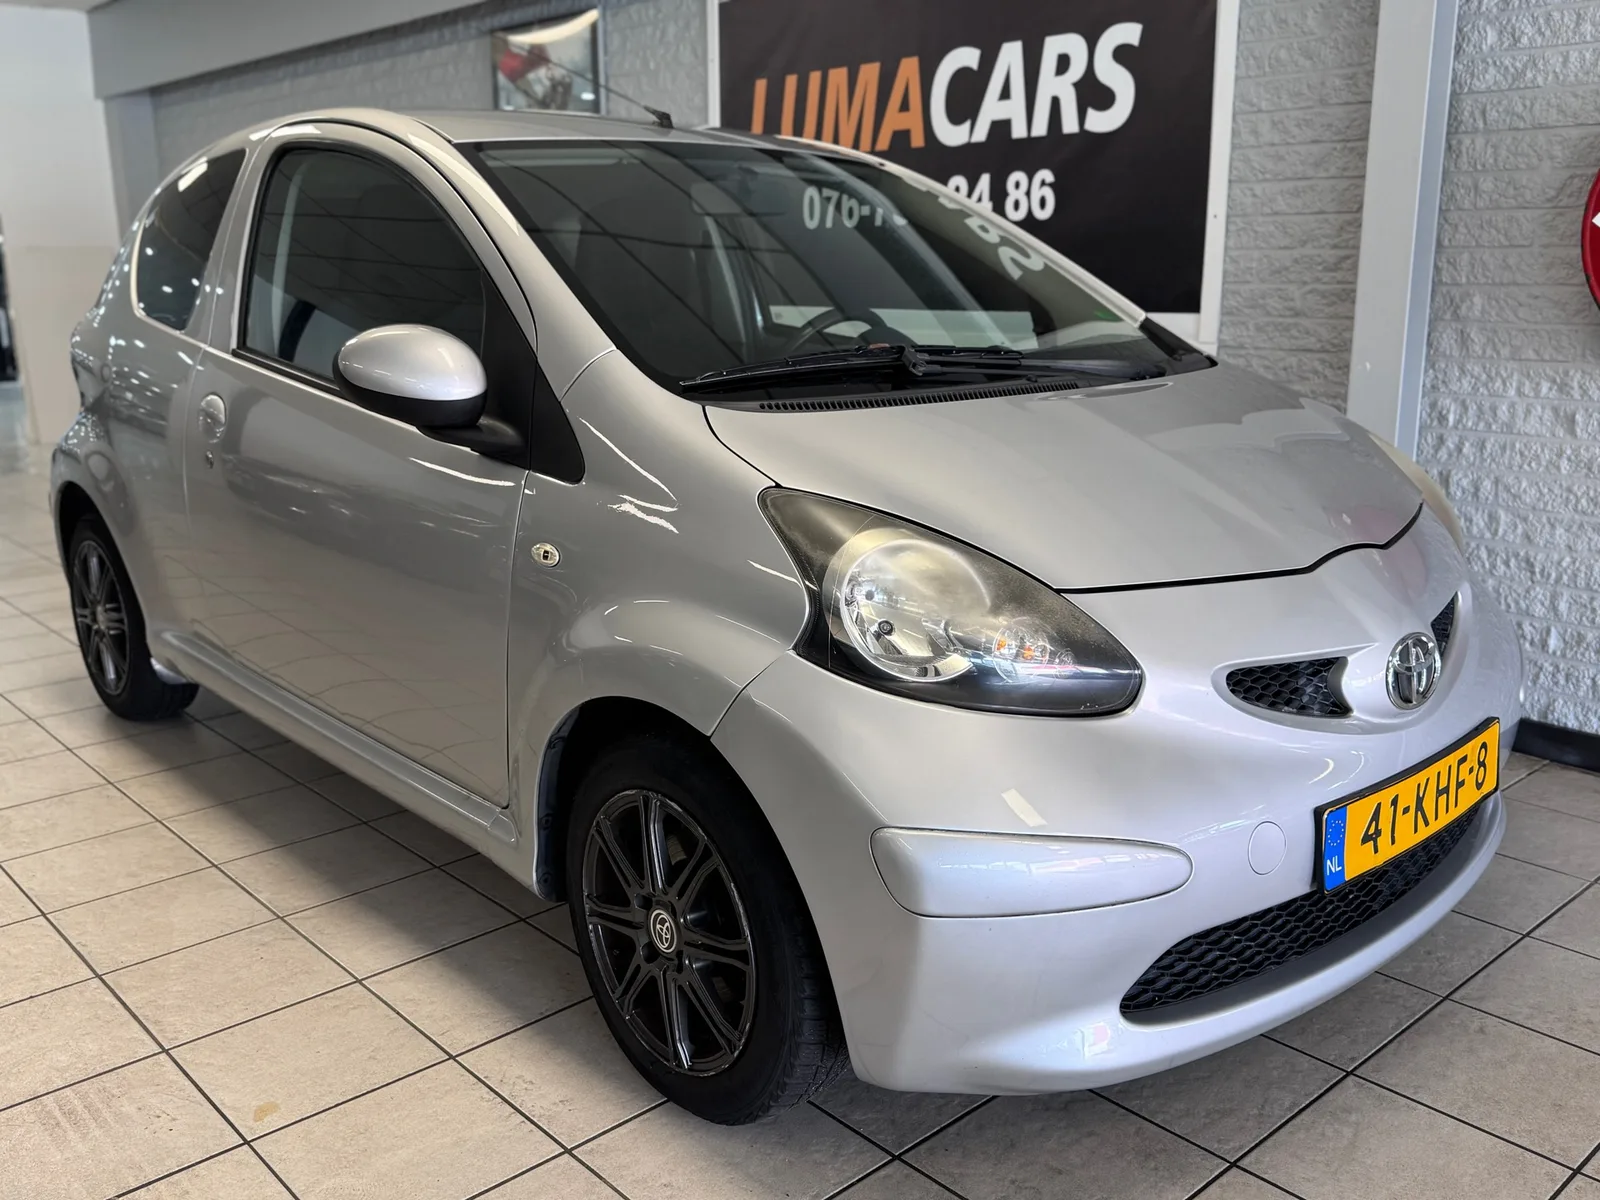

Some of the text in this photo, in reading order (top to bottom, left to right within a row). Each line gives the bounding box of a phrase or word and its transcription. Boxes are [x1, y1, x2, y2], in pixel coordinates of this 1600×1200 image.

[1005, 168, 1055, 222] 86
[1360, 741, 1487, 855] 41-KHF-8
[1326, 854, 1342, 877] NL
